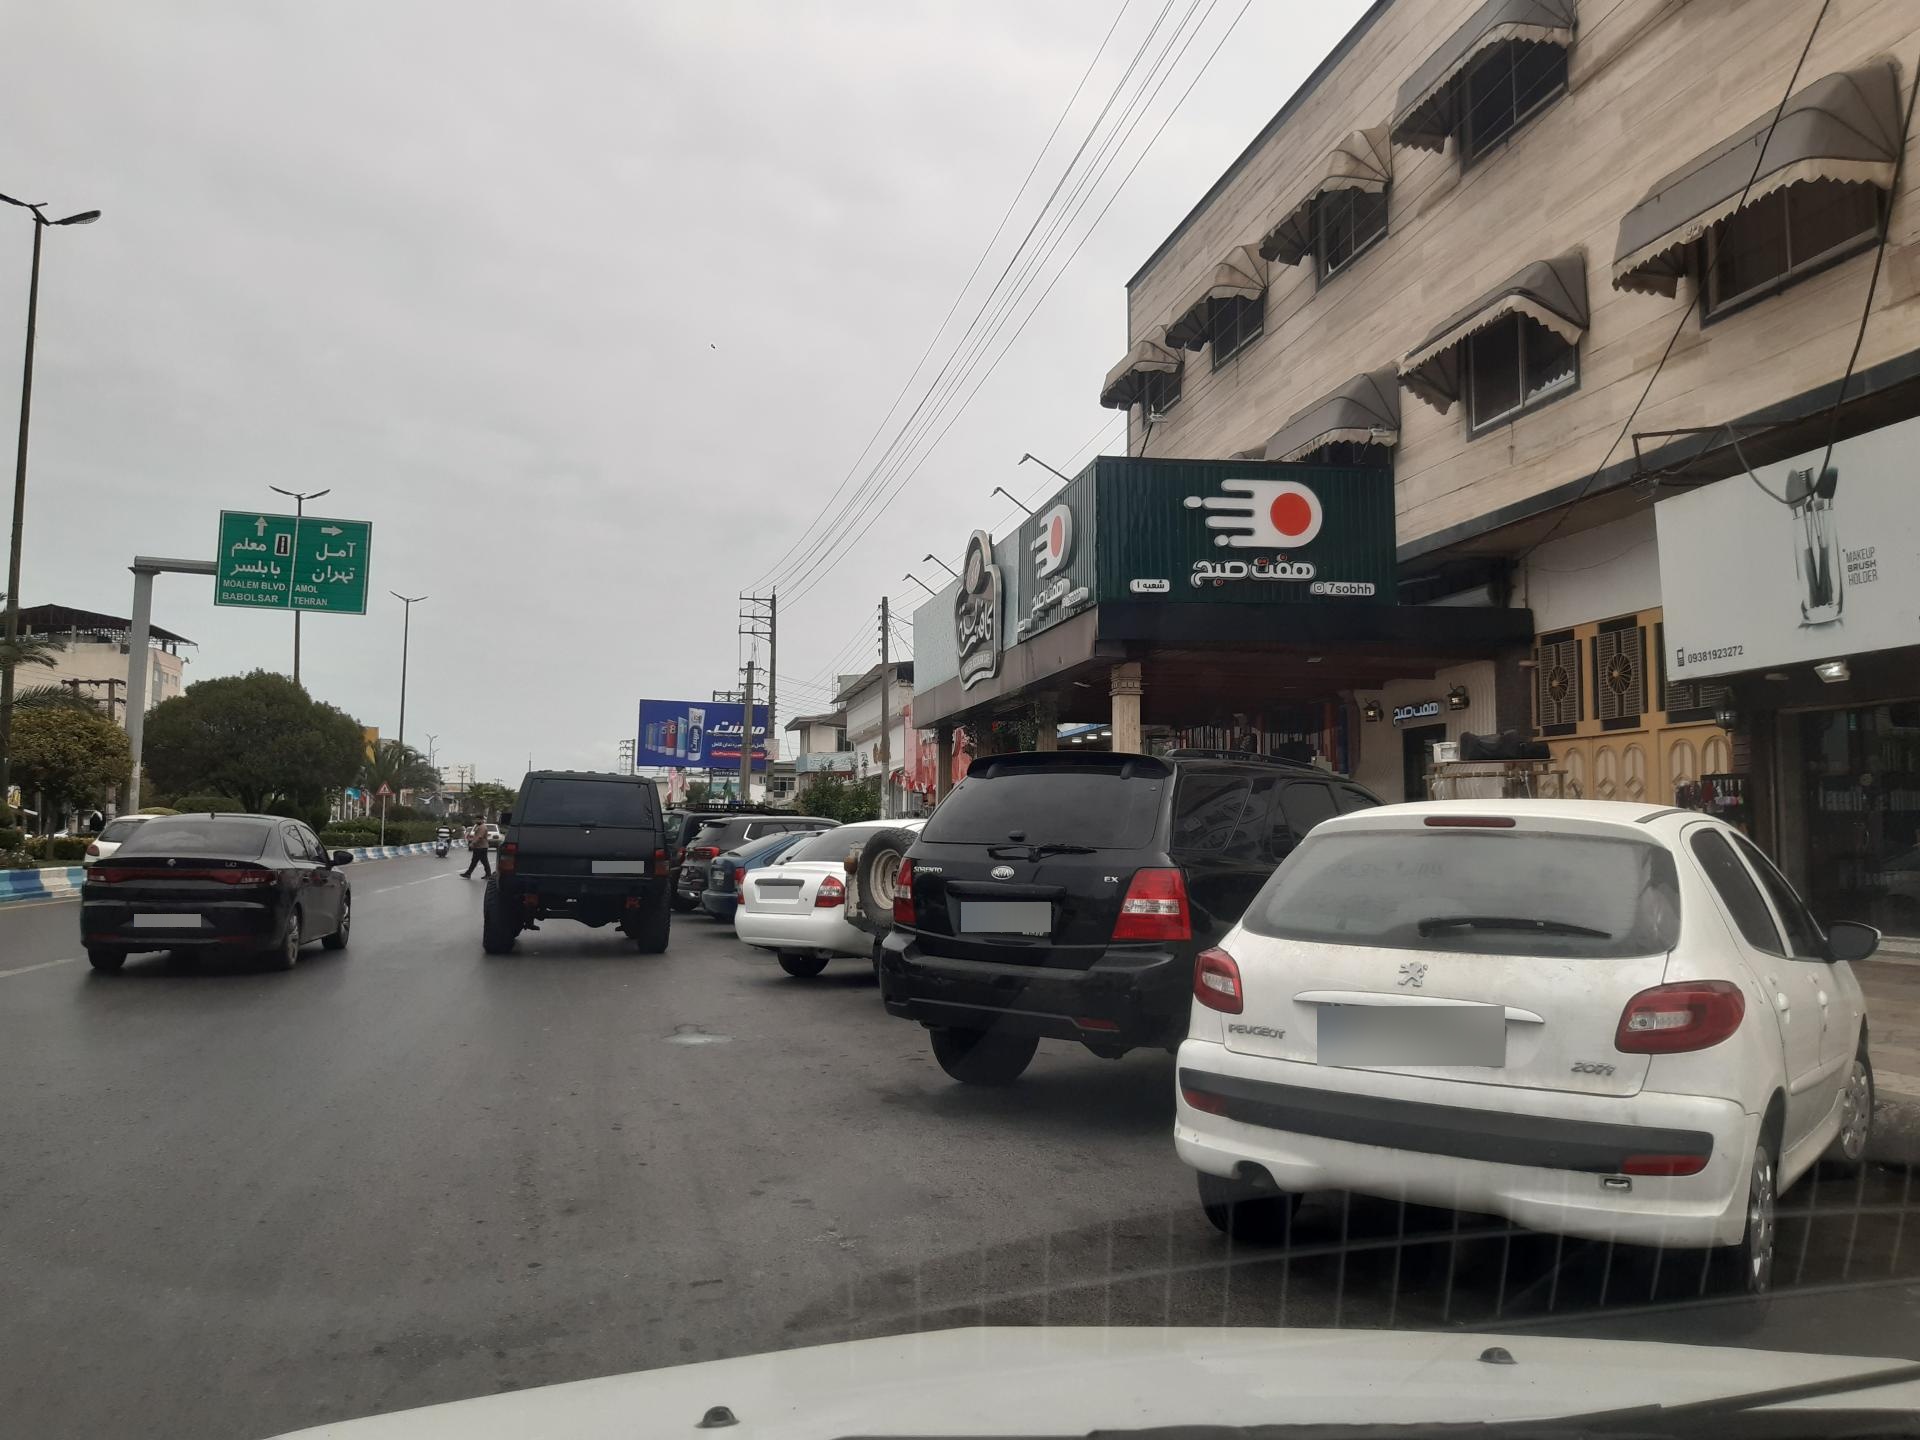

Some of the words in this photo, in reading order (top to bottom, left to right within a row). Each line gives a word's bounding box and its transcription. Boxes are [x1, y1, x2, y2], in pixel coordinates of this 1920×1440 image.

[231, 537, 267, 557] معلم
[315, 542, 357, 561] آمل
[1845, 547, 1876, 563] MAKEUP
[230, 559, 281, 579] بابلسر
[1191, 560, 1249, 588] صبح
[1251, 554, 1315, 578] هفت
[1847, 560, 1877, 573] BRUSH
[312, 565, 355, 584] تهران
[1848, 569, 1878, 586] HOLDER
[223, 579, 259, 590] MOALEM
[261, 582, 288, 592] BLVD.
[294, 584, 318, 594] AMOL
[1143, 580, 1166, 592] شعبه
[1328, 582, 1372, 595] 7sobhh
[222, 592, 279, 604] BABOLSAR
[294, 596, 328, 607] TEHRAN
[1687, 645, 1744, 664] 09381923272
[1103, 875, 1119, 884] EX
[1228, 1024, 1286, 1040] PEUGEOT
